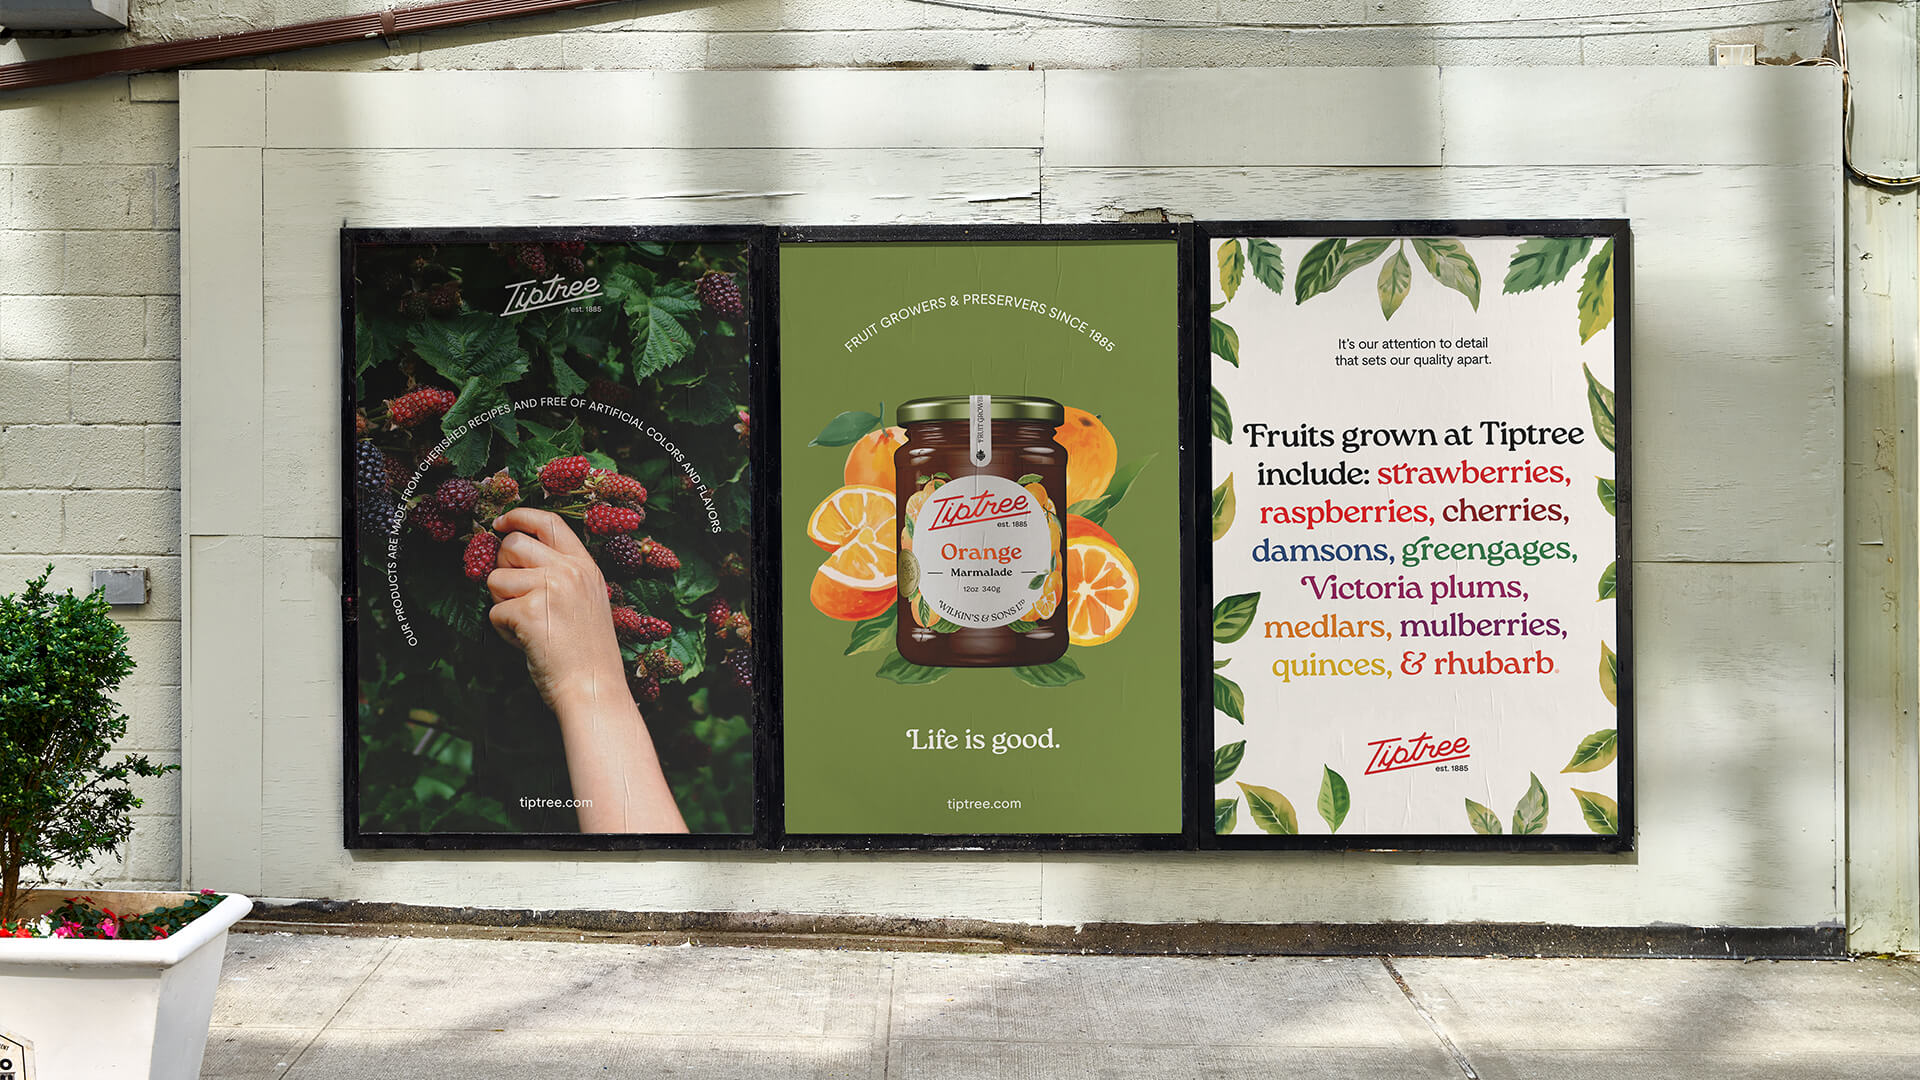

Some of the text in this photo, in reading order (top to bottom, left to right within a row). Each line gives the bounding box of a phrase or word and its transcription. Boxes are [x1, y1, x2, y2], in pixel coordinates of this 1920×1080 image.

[500, 273, 603, 317] Tiptree
[844, 293, 1116, 353] FRUIT GROWERS & PRESERVERS SINCE 1885
[1338, 337, 1489, 350] It's our attention to detail
[1335, 353, 1492, 368] that sets our quality apart.
[1243, 421, 1585, 453] Fruits grown at Tiptree
[1257, 460, 1572, 487] include: strawberries,
[387, 397, 722, 647] OUR PRODUCTS ARE MADE FROM CHERISHED RECIPES AND FREE OF ARTIFICIAL COLORS AND FLAVORS
[928, 490, 1031, 531] Tiptree
[1260, 498, 1570, 530] raspberries, cherries,
[941, 543, 1023, 565] Orange
[1252, 536, 1578, 567] damsons, greengages,
[950, 568, 1013, 577] Marmalade
[981, 585, 1001, 593] 340g
[1301, 574, 1529, 605] Victoria plums,
[981, 614, 989, 622] &
[991, 606, 1017, 621] SONS
[1264, 612, 1568, 642] medlars, mulberries,
[1272, 652, 1393, 683] quinces,
[1400, 651, 1427, 676] &
[905, 727, 1061, 755] Life is good.
[1364, 731, 1470, 775] Tiptree
[519, 797, 593, 810] tiptree.com
[946, 798, 1022, 812] tiptree.com
